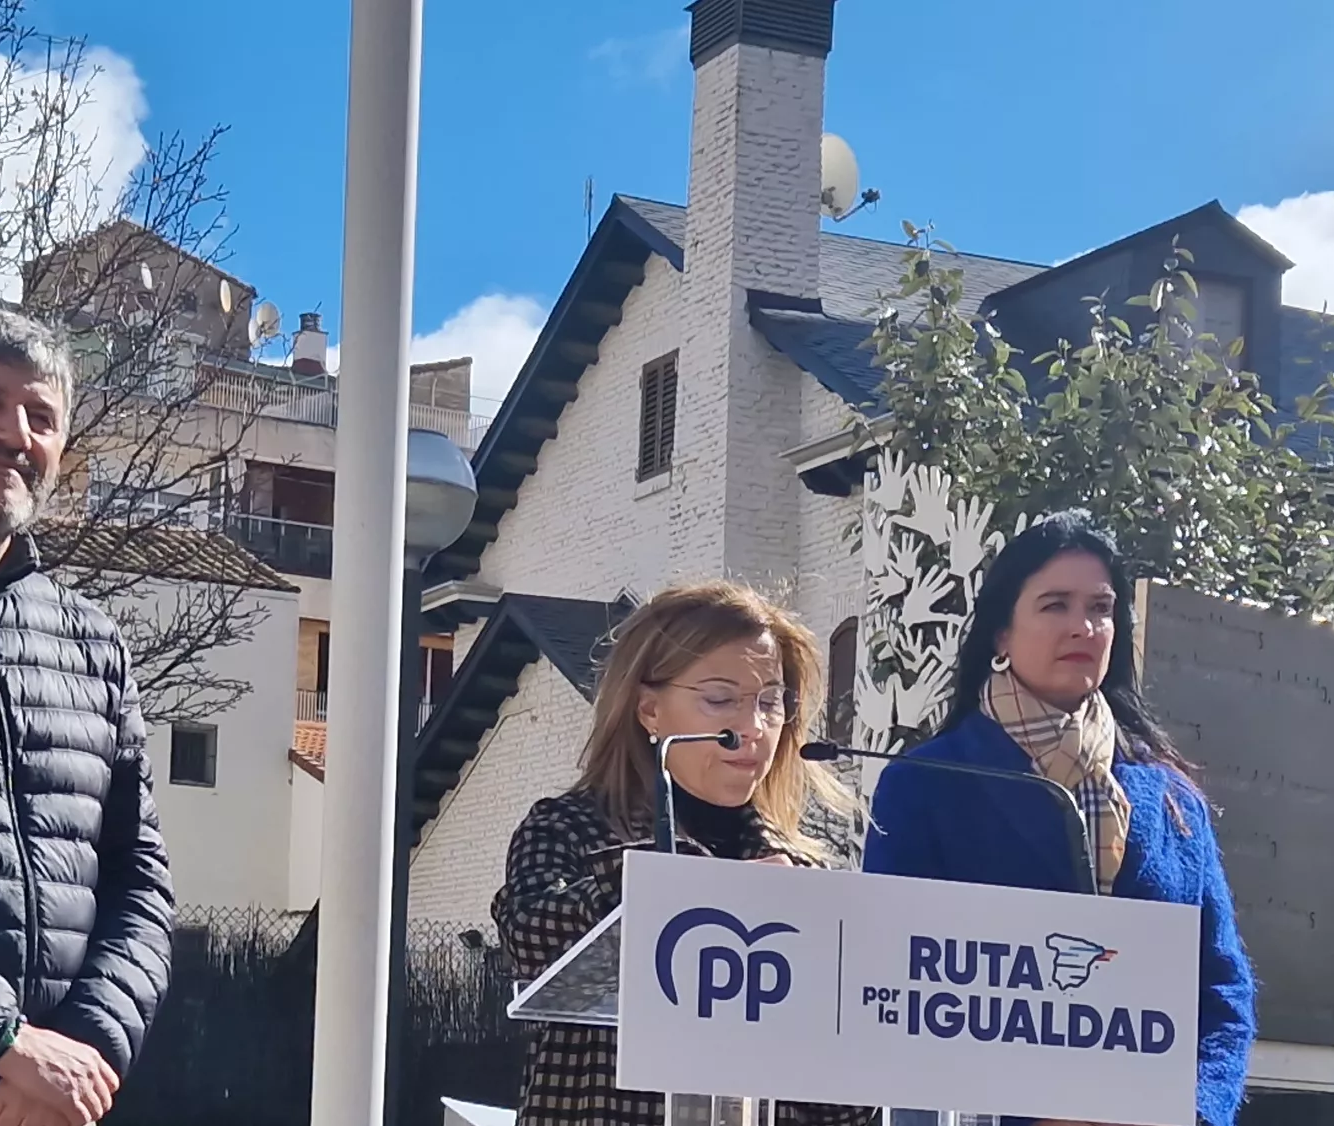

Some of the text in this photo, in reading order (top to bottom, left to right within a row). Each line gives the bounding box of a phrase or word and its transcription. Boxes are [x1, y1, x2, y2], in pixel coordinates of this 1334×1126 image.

[908, 934, 1044, 991] RUTA
[862, 985, 901, 1006] por
[878, 1002, 899, 1025] la
[907, 989, 1176, 1055] IGUALDAD
